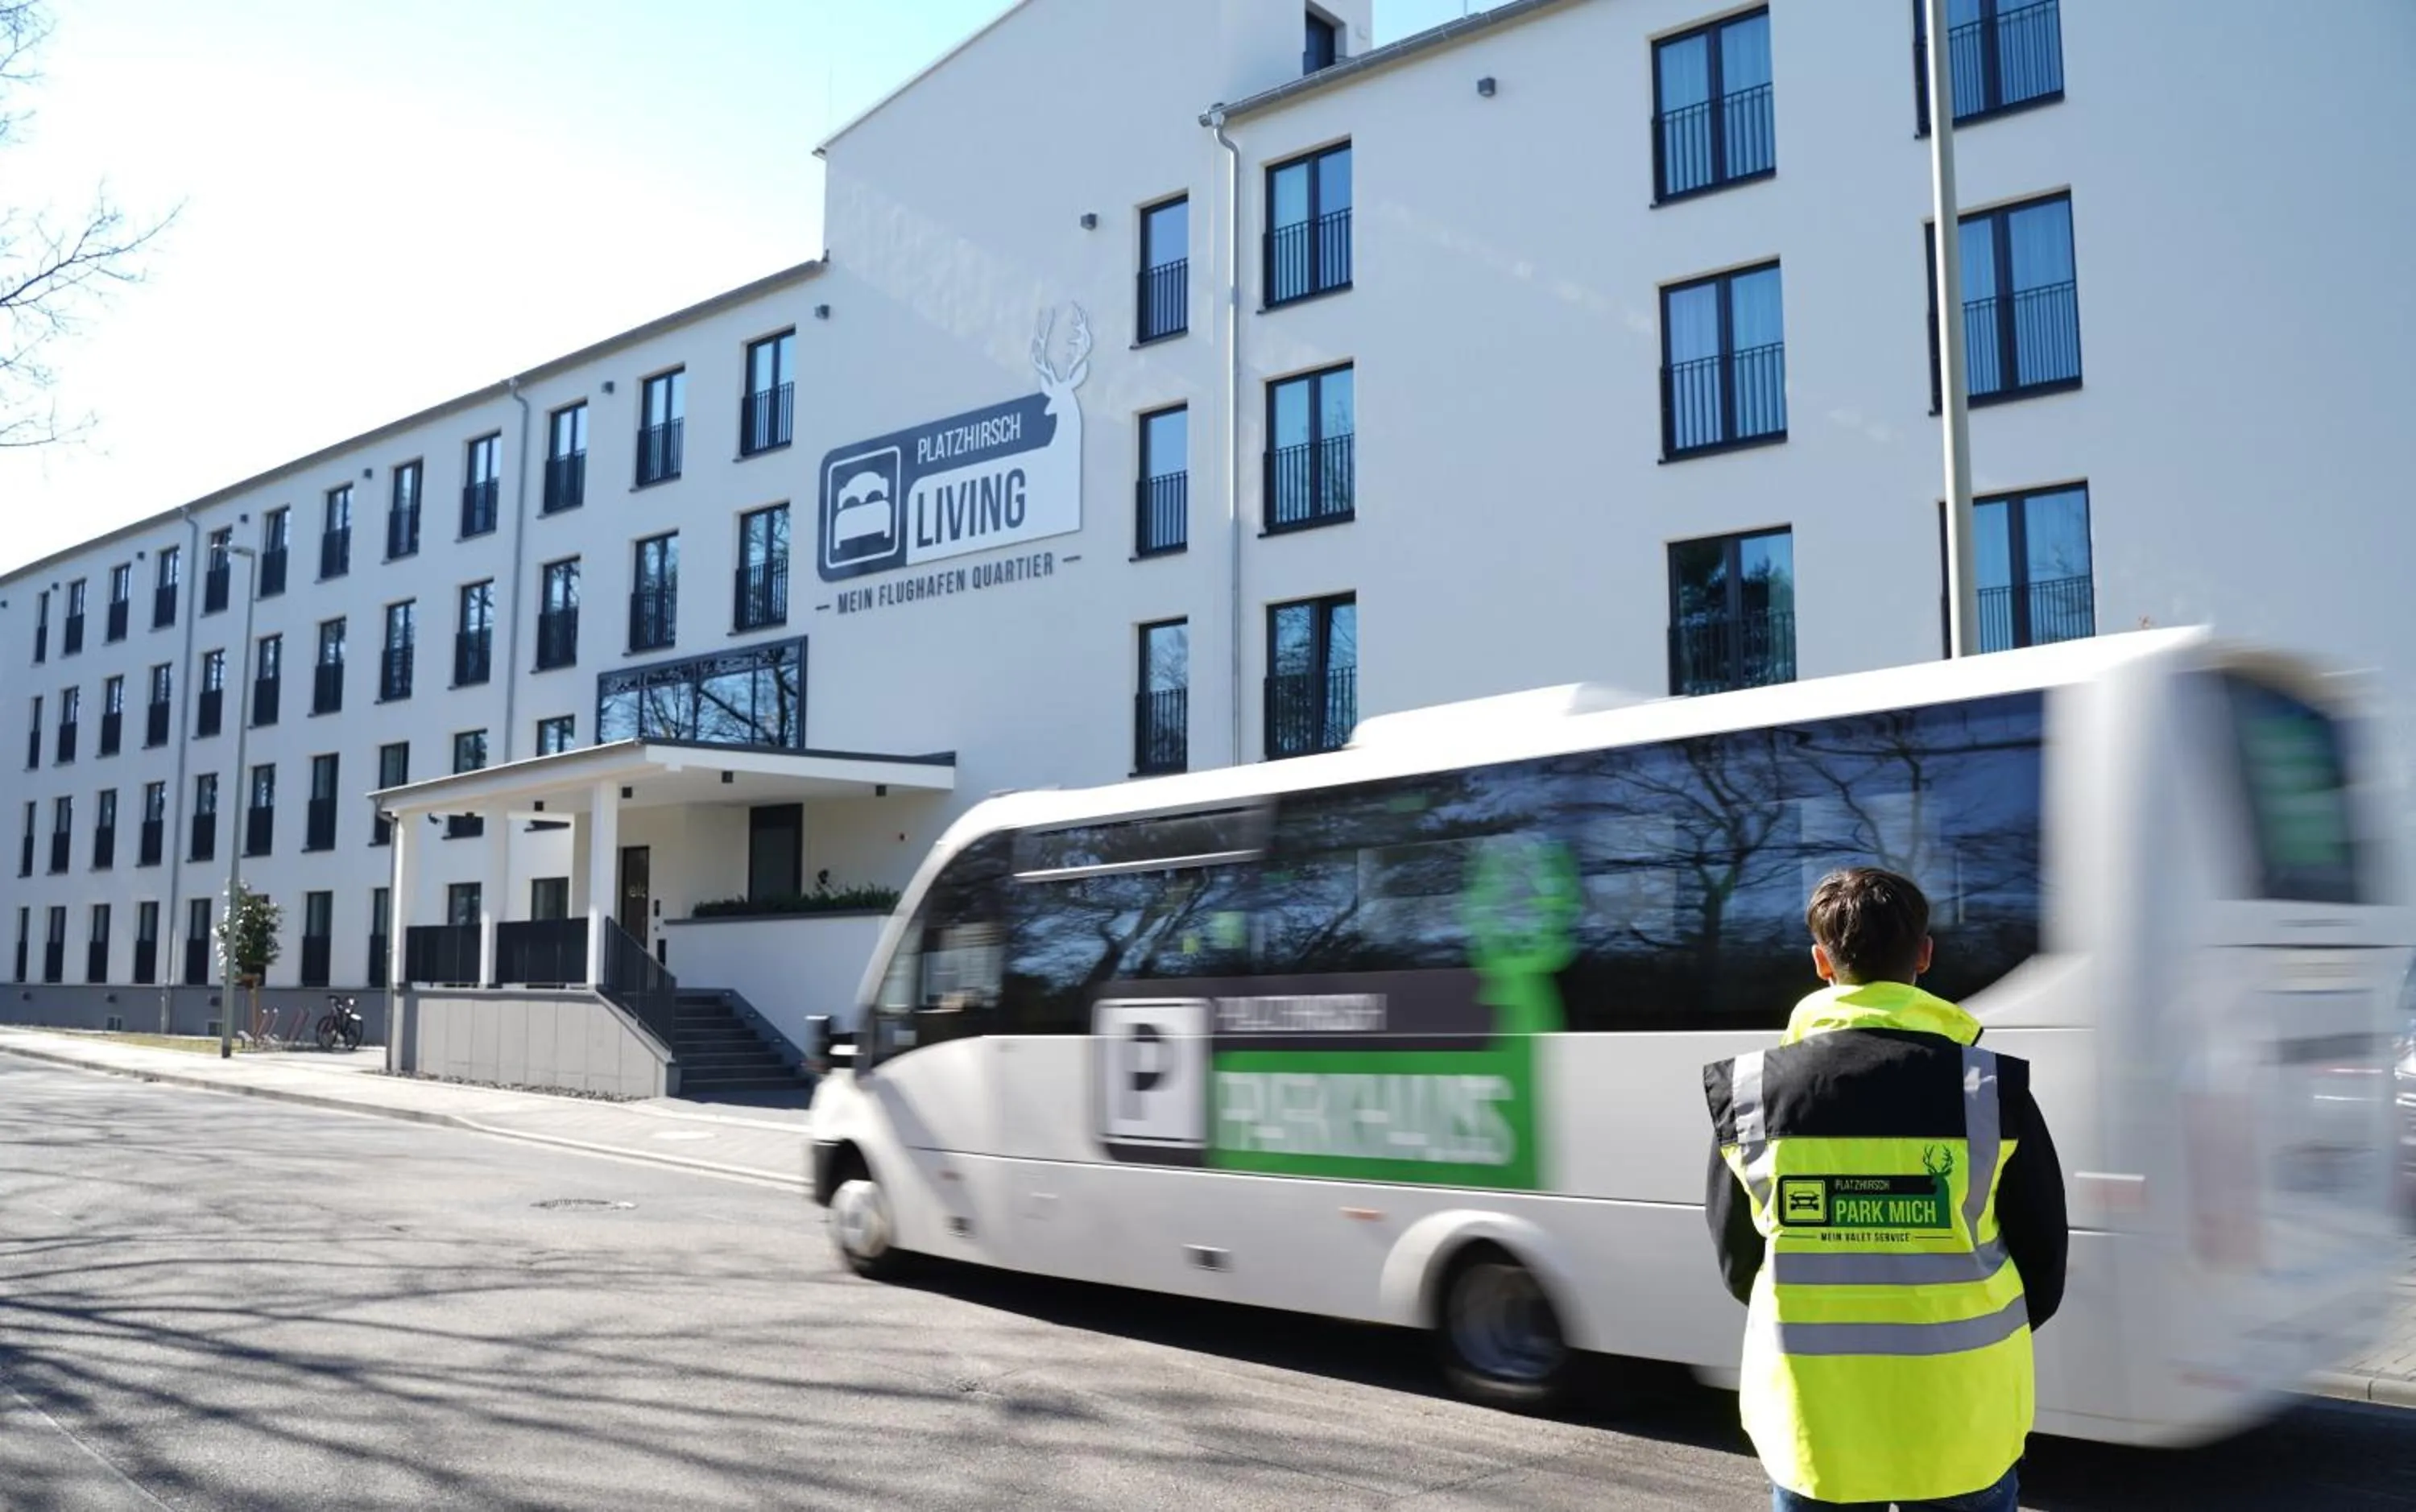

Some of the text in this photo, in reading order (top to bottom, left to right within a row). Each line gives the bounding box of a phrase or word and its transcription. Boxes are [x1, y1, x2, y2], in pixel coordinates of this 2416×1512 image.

[917, 412, 1021, 465] PLATZHIRSCH
[916, 468, 1026, 548] LIVING
[838, 552, 1053, 614] MEIN FLUGHAFEN QUARTIER
[1835, 1179, 1890, 1191] PLATZHIRSCH
[1836, 1200, 1937, 1224] PARK MICH
[1821, 1233, 1911, 1241] MEIN VALET SERVICE
